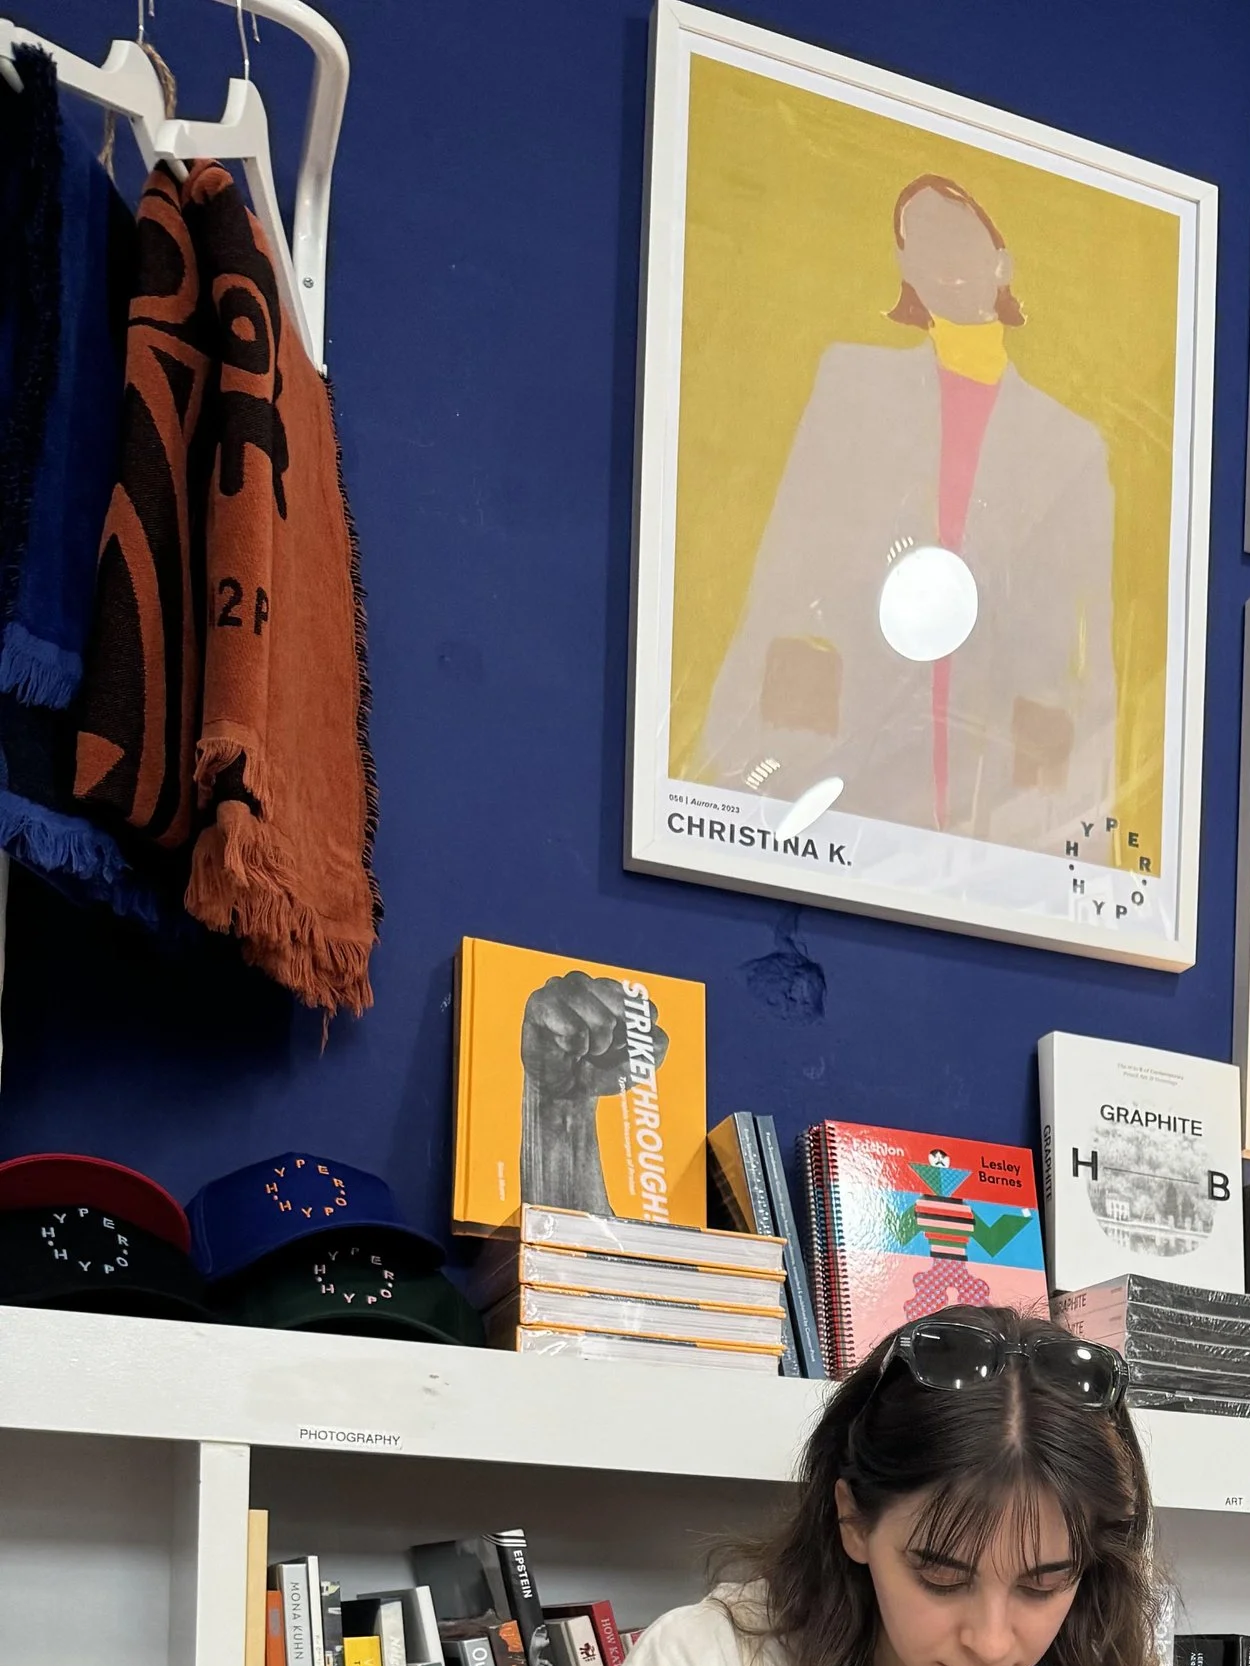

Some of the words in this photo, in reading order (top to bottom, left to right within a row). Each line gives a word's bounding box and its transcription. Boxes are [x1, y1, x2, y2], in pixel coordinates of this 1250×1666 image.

[690, 798, 721, 811] Aurora,
[721, 804, 741, 814] 2023
[667, 812, 819, 860] CHRISTINA
[829, 842, 852, 867] K.
[1100, 1103, 1203, 1138] GRAPHITE
[978, 1170, 1023, 1189] Barnes
[980, 1155, 1022, 1177] Lesley
[1041, 1124, 1054, 1202] GRAPHITE
[1071, 1147, 1099, 1182] H
[1207, 1170, 1231, 1202] B
[299, 1428, 401, 1447] PHOTOGRAPHY
[1225, 1497, 1244, 1507] ART
[512, 1549, 533, 1599] EPSTEIN
[290, 1582, 302, 1622] MONA
[292, 1622, 305, 1660] KUHN
[600, 1617, 616, 1645] HOW
